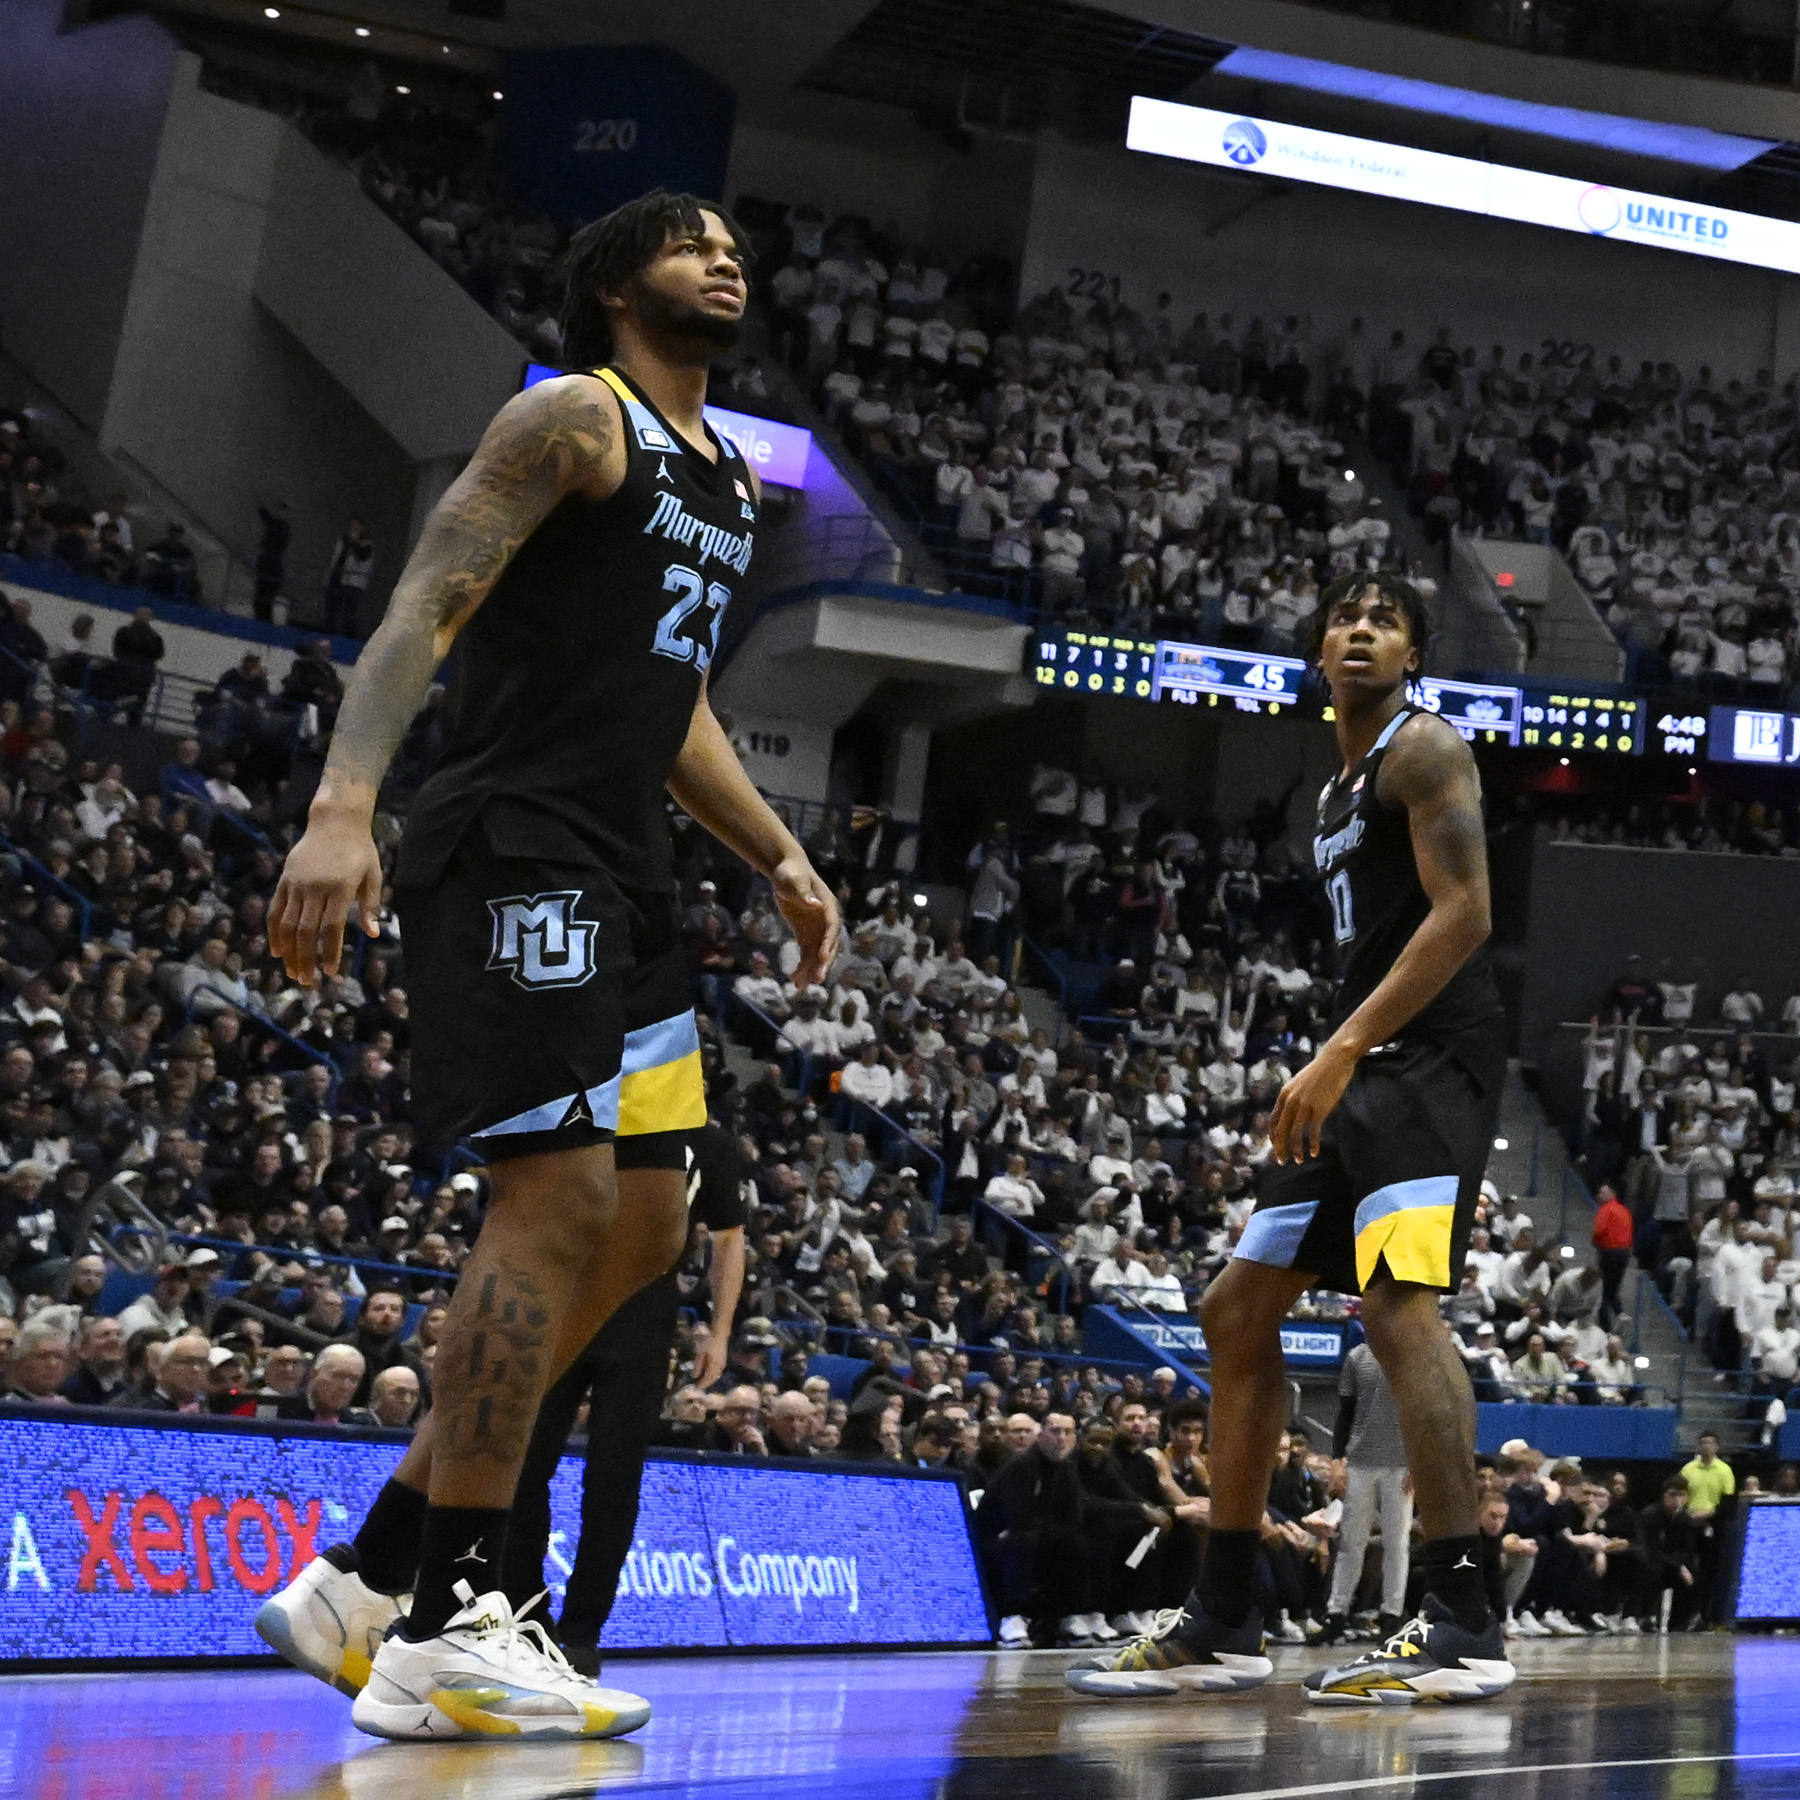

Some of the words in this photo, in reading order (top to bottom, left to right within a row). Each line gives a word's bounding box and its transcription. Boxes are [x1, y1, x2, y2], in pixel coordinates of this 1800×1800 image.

[572, 118, 638, 152] 220
[1626, 202, 1729, 240] UNITED
[643, 490, 755, 577] Marquett
[649, 563, 733, 676] 23
[1040, 641, 1058, 660] 11
[1067, 645, 1081, 663] 7
[1092, 649, 1104, 667] 1
[1113, 652, 1129, 671] 3
[1140, 655, 1151, 673] 1
[1035, 665, 1057, 685] 12
[1063, 669, 1080, 688] 0
[1087, 673, 1104, 691] 0
[1111, 676, 1126, 694] 3
[1135, 679, 1151, 697] 0
[1243, 663, 1287, 692] 45
[1523, 705, 1544, 723] 10
[1547, 707, 1568, 725] 14
[1572, 709, 1588, 726] 4
[1595, 711, 1610, 728] 4
[1620, 713, 1631, 730] 1
[1656, 713, 1707, 737] 4:48
[1523, 728, 1540, 746] 11
[1547, 730, 1563, 747] 4
[1570, 732, 1585, 749] 2
[1593, 733, 1609, 751] 4
[1616, 735, 1633, 752] 0
[1663, 735, 1696, 755] PM
[484, 889, 600, 992] MU
[6, 1511, 52, 1593] A
[65, 1488, 324, 1594] xerox
[717, 1537, 860, 1613] Company
